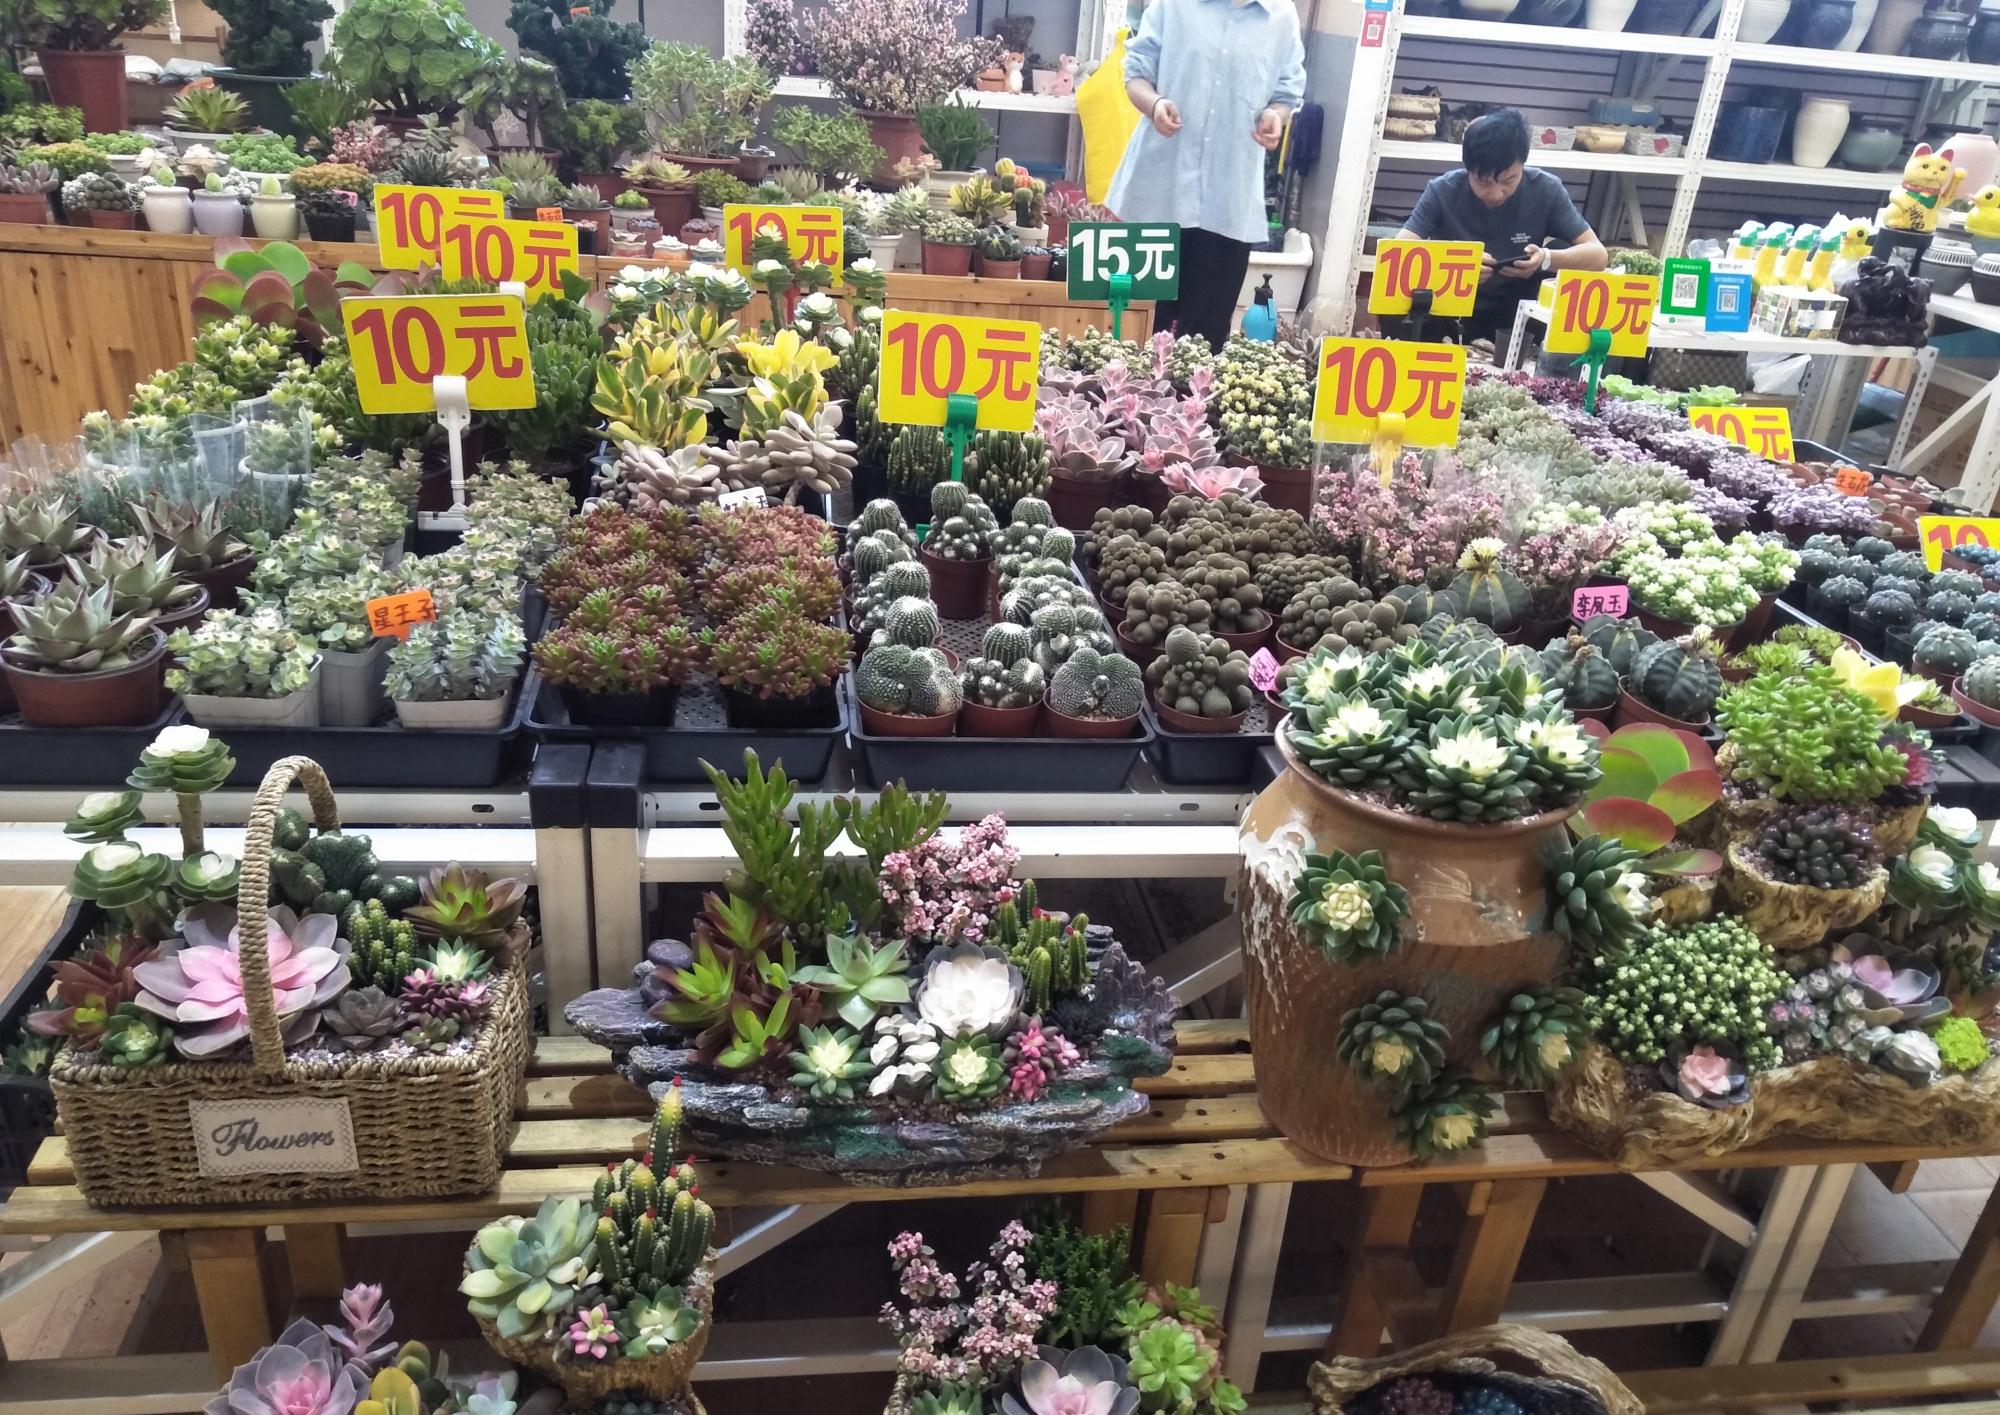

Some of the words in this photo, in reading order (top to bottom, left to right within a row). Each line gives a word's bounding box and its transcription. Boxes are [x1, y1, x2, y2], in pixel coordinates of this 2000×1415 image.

[445, 224, 571, 290] 10元
[1072, 228, 1176, 282] 15元
[1379, 246, 1476, 299] 10元
[1559, 277, 1652, 335] 10元
[351, 306, 524, 385] 10元
[888, 322, 1032, 401] 10元
[1325, 345, 1458, 420] 10元
[374, 599, 434, 631] 星王子
[211, 1117, 336, 1157] Flowers
